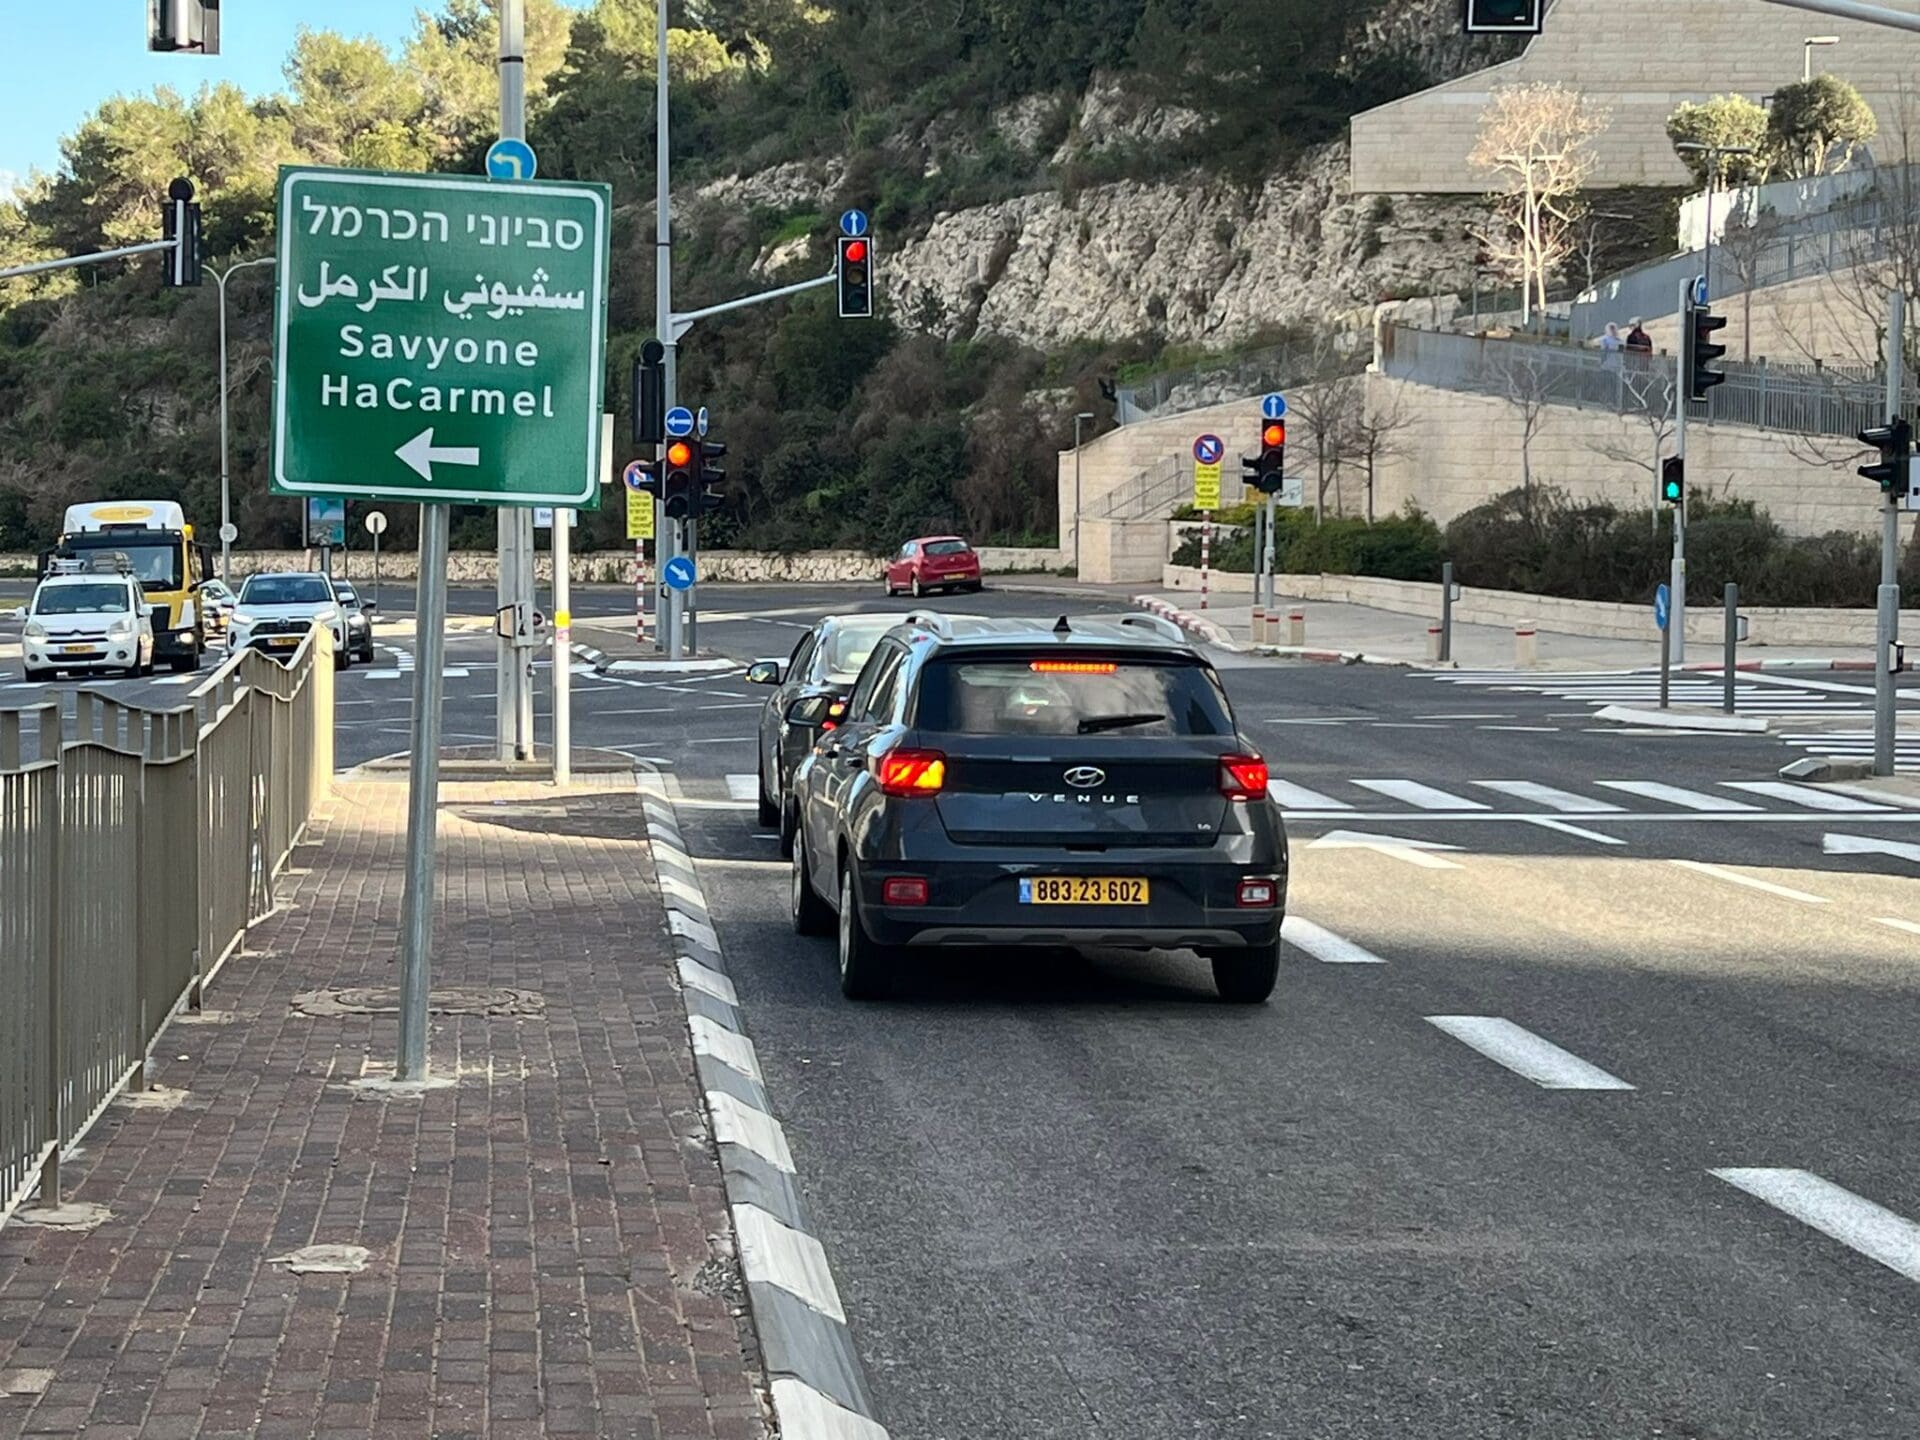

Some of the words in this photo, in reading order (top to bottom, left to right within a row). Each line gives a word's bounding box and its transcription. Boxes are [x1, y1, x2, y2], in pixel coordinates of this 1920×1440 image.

[302, 195, 448, 242] הכרמל
[467, 214, 583, 250] סביוני
[297, 260, 428, 312] الكرمل
[339, 325, 539, 370] Savyone
[321, 374, 554, 418] HaCarmel
[1028, 793, 1139, 803] VENUE
